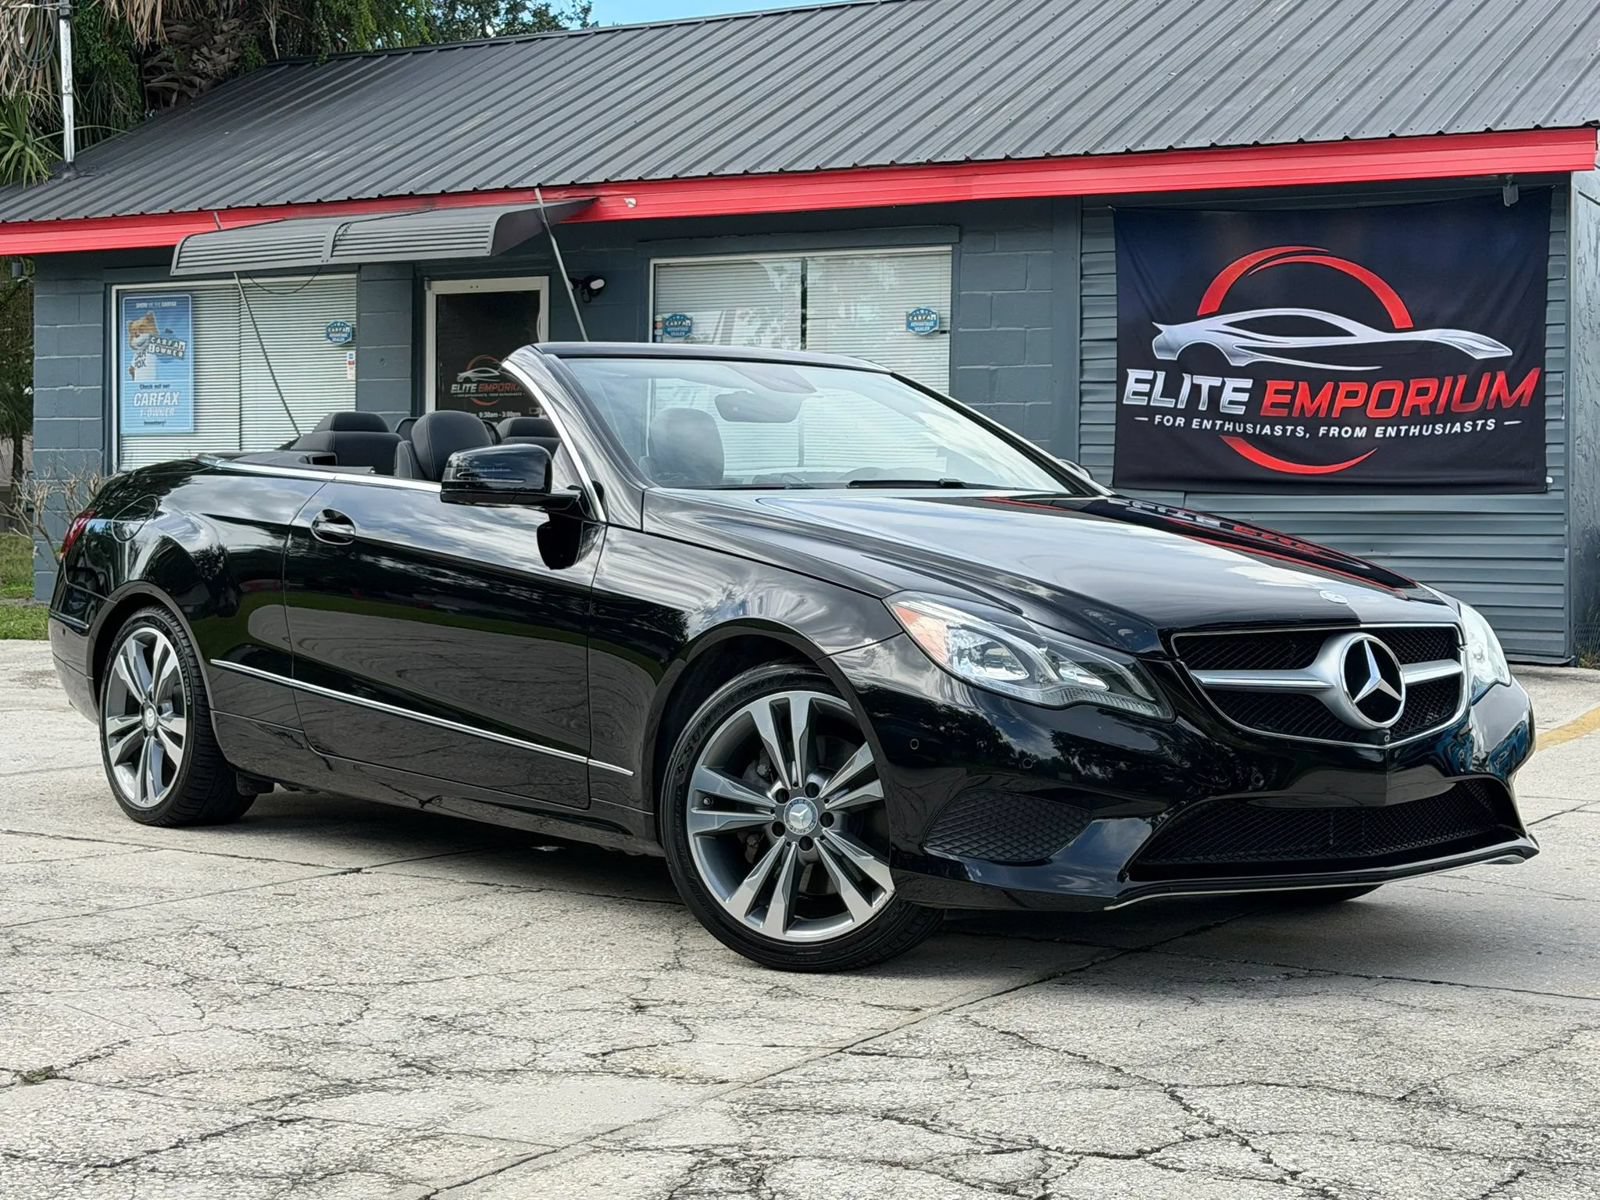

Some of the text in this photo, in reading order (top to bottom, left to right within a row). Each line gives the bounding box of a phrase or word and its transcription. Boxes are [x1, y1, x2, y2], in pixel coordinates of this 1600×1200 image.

[450, 383, 478, 394] ELITE
[1122, 367, 1542, 418] ELITE EMPORIUM
[133, 391, 180, 407] CARFAX
[1154, 414, 1497, 439] FOR ENTHUSIASTS, FROM ENTHUSIASTS
